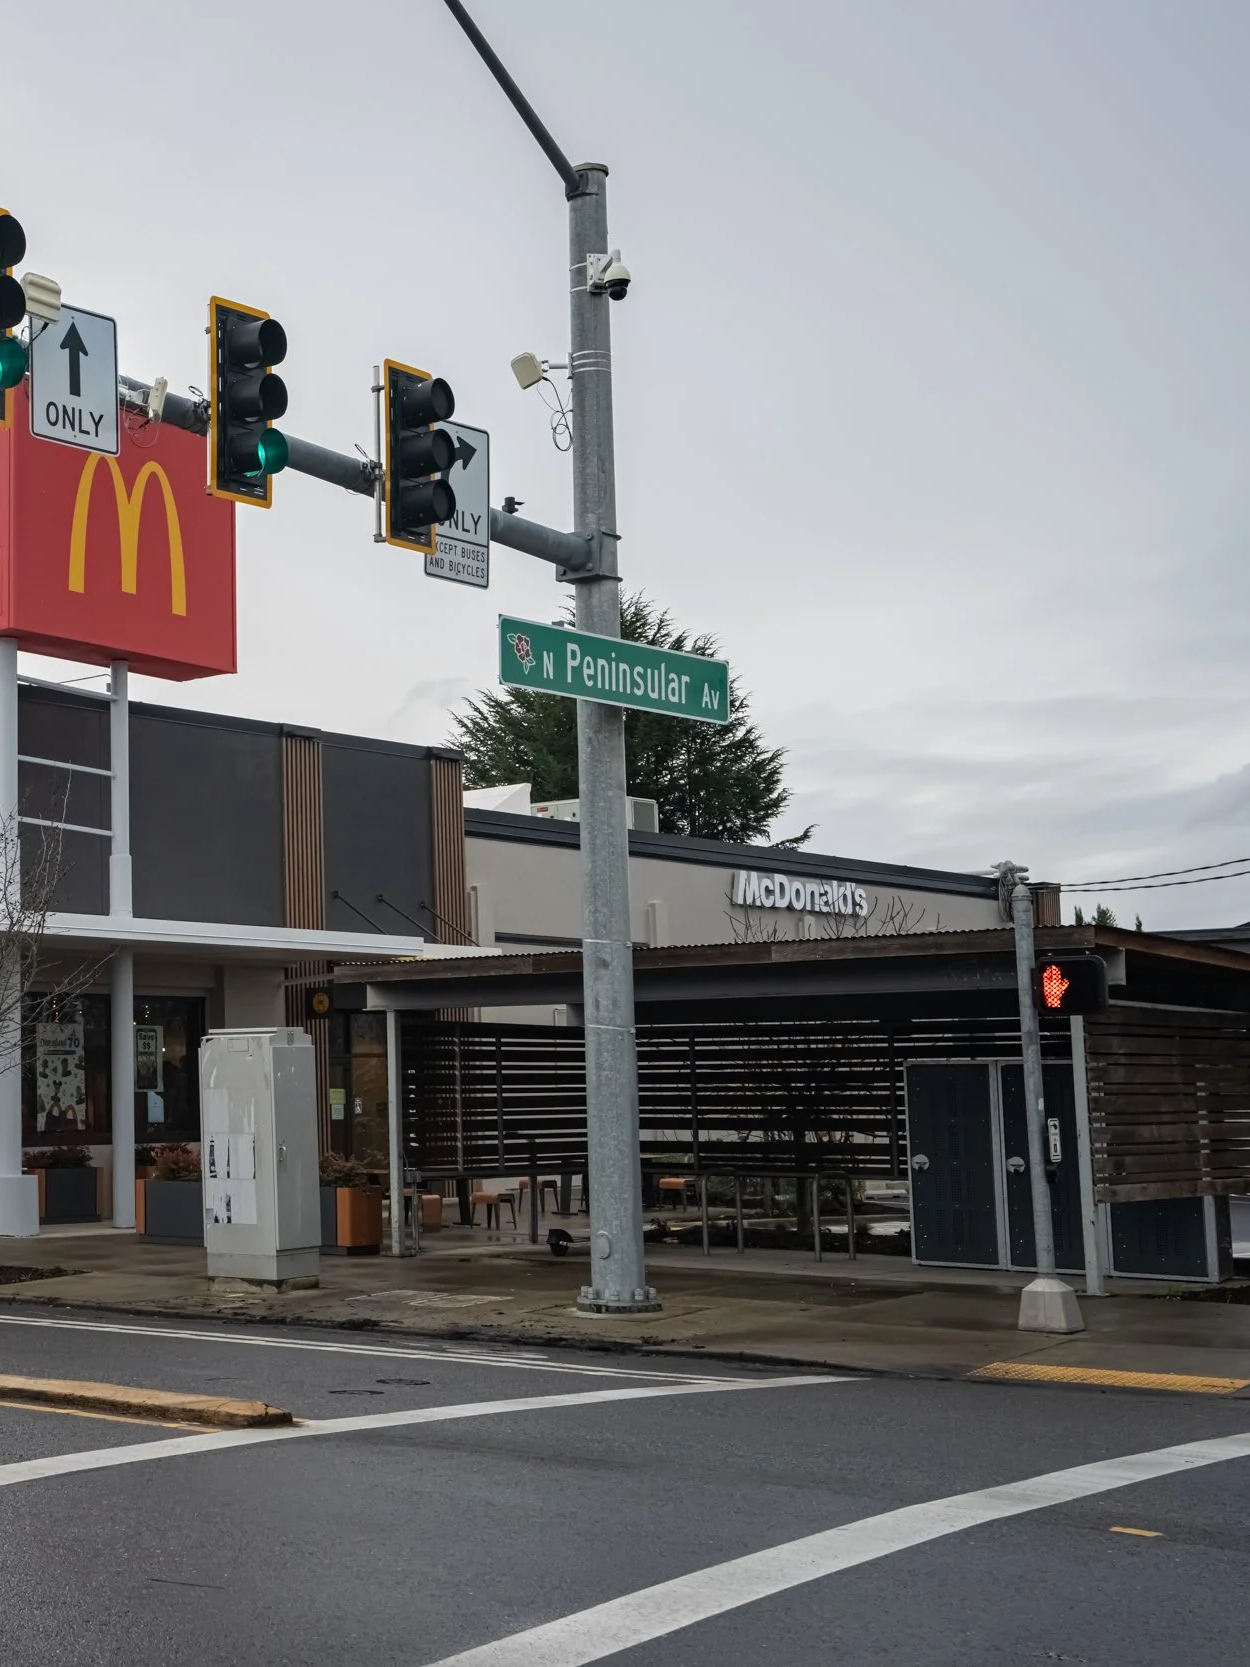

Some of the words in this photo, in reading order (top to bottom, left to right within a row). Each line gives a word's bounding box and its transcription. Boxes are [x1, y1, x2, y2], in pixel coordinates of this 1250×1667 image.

[46, 401, 104, 437] ONLY
[461, 547, 485, 563] BUSES
[429, 556, 445, 569] AND
[448, 560, 485, 579] BICYCLES
[543, 650, 554, 680] N
[566, 642, 690, 704] Peninsular
[701, 682, 720, 710] Av
[732, 870, 868, 916] McDonald's
[67, 1037, 80, 1048] 70
[138, 1032, 155, 1041] Save
